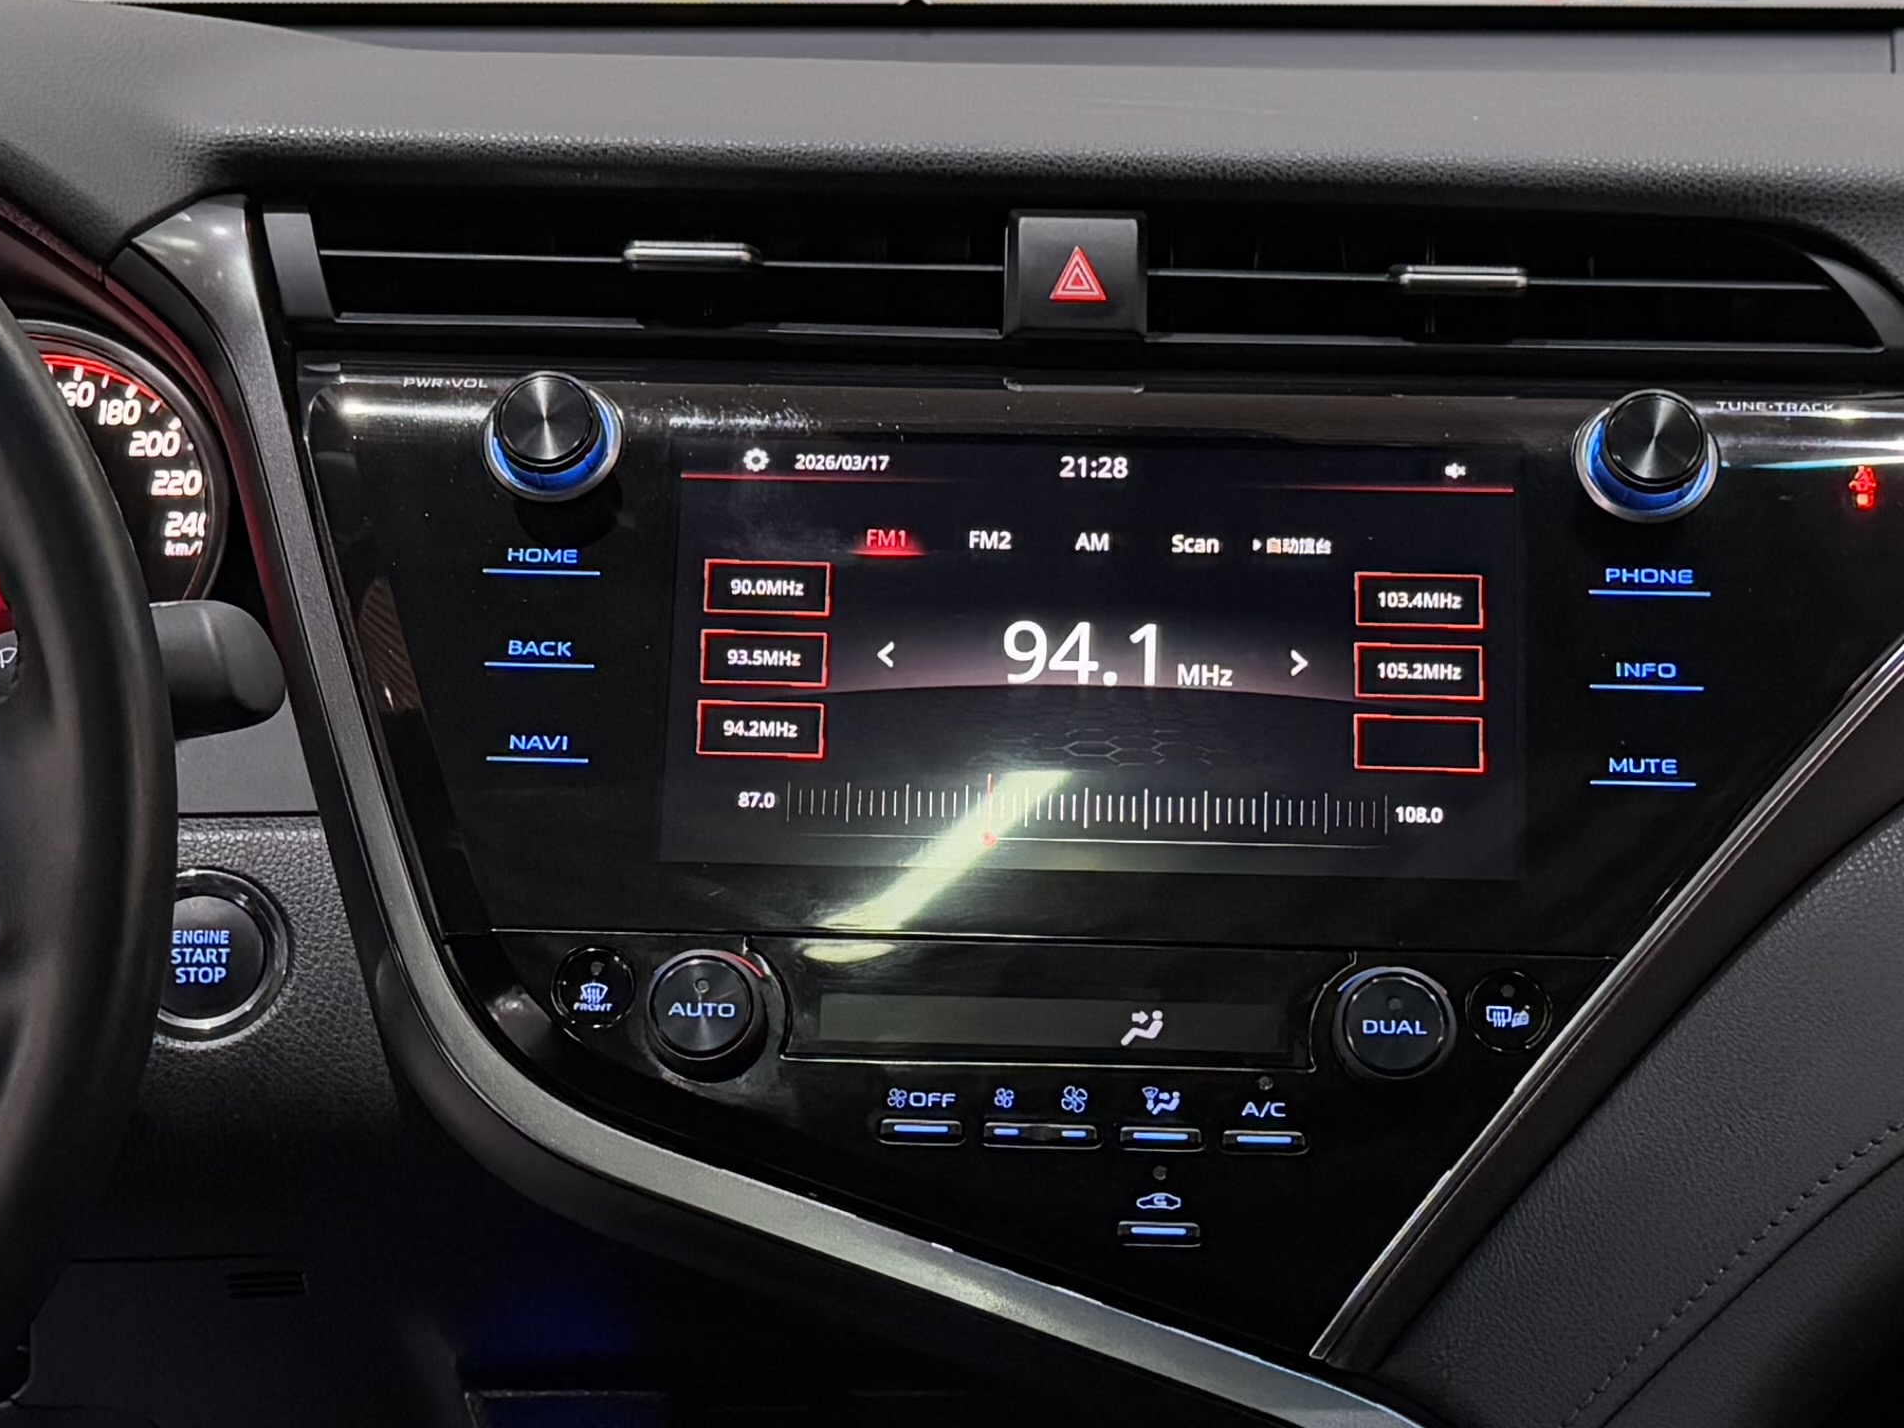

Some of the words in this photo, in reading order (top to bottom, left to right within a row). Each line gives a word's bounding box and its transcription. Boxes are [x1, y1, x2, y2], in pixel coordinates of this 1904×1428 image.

[98, 398, 141, 426] 180
[128, 431, 182, 458] 200
[793, 452, 890, 472] 2026/03/17
[1060, 456, 1128, 478] 21:28
[150, 469, 202, 496] 220
[865, 529, 907, 548] FM1
[969, 531, 1011, 549] FM2
[1075, 533, 1109, 551] AM
[1172, 534, 1219, 553] Scan
[508, 548, 577, 564] HOME
[1606, 568, 1693, 584] PHONE
[731, 579, 803, 596] 90.0MHz
[1378, 592, 1461, 609] 103.4MHz
[507, 639, 572, 657] BACK
[1003, 620, 1160, 686] 94.1
[1177, 664, 1232, 688] MHz
[728, 649, 801, 666] 93.5MHz
[1378, 663, 1461, 680] 105.2MHz
[1616, 663, 1677, 678] INFO
[723, 720, 797, 737] 94.2MHz
[510, 735, 568, 750] NAVI
[1609, 758, 1677, 774] MUTE
[738, 792, 775, 808] 87.0
[1396, 806, 1443, 823] 108.0
[171, 929, 230, 946] ENGINE
[171, 948, 230, 966] START
[174, 966, 227, 984] STOP
[573, 1002, 613, 1013] FRONT
[666, 1000, 737, 1019] AUTO
[1363, 1020, 1427, 1034] DUAL
[908, 1090, 957, 1109] OFF
[1242, 1102, 1285, 1117] A/C
